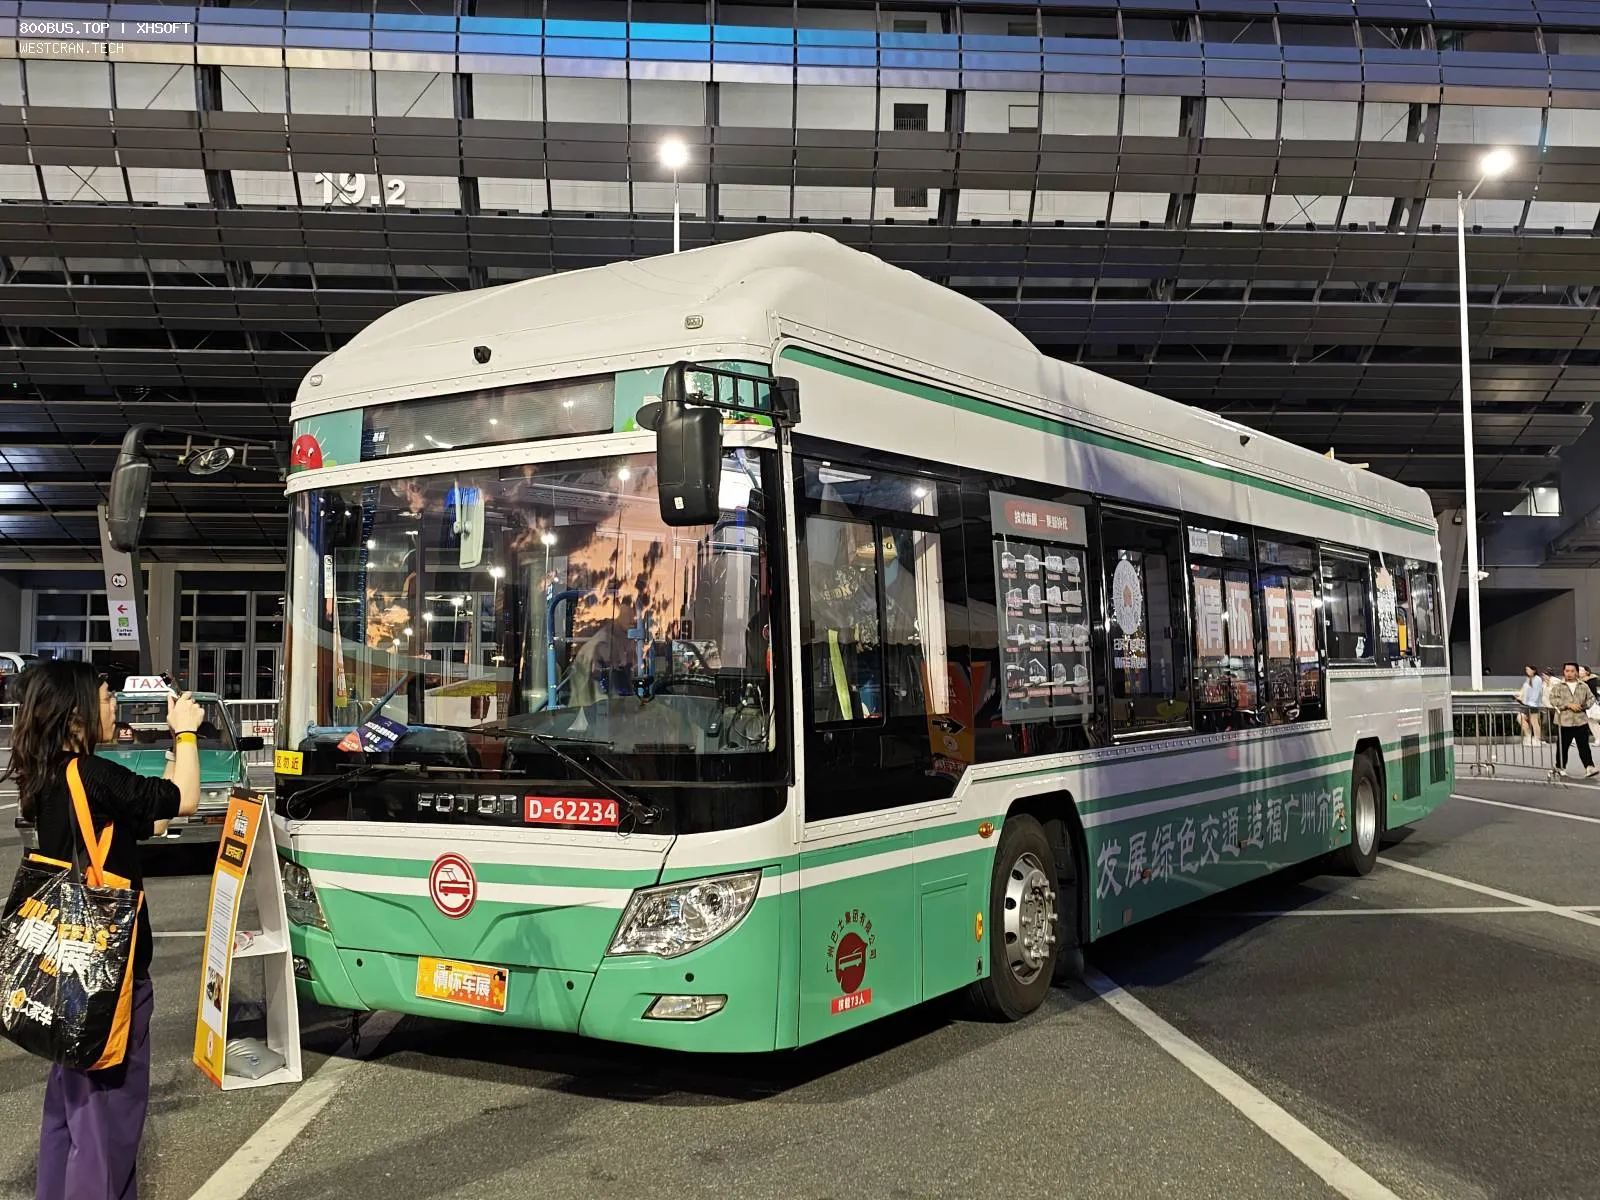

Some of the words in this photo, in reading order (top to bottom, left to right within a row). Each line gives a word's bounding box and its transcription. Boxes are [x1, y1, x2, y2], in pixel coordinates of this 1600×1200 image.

[315, 173, 406, 205] 19.2
[129, 678, 165, 689] TAX
[417, 793, 518, 814] FOTON
[529, 800, 617, 823] D-62234
[433, 969, 491, 998] 情怀车展
